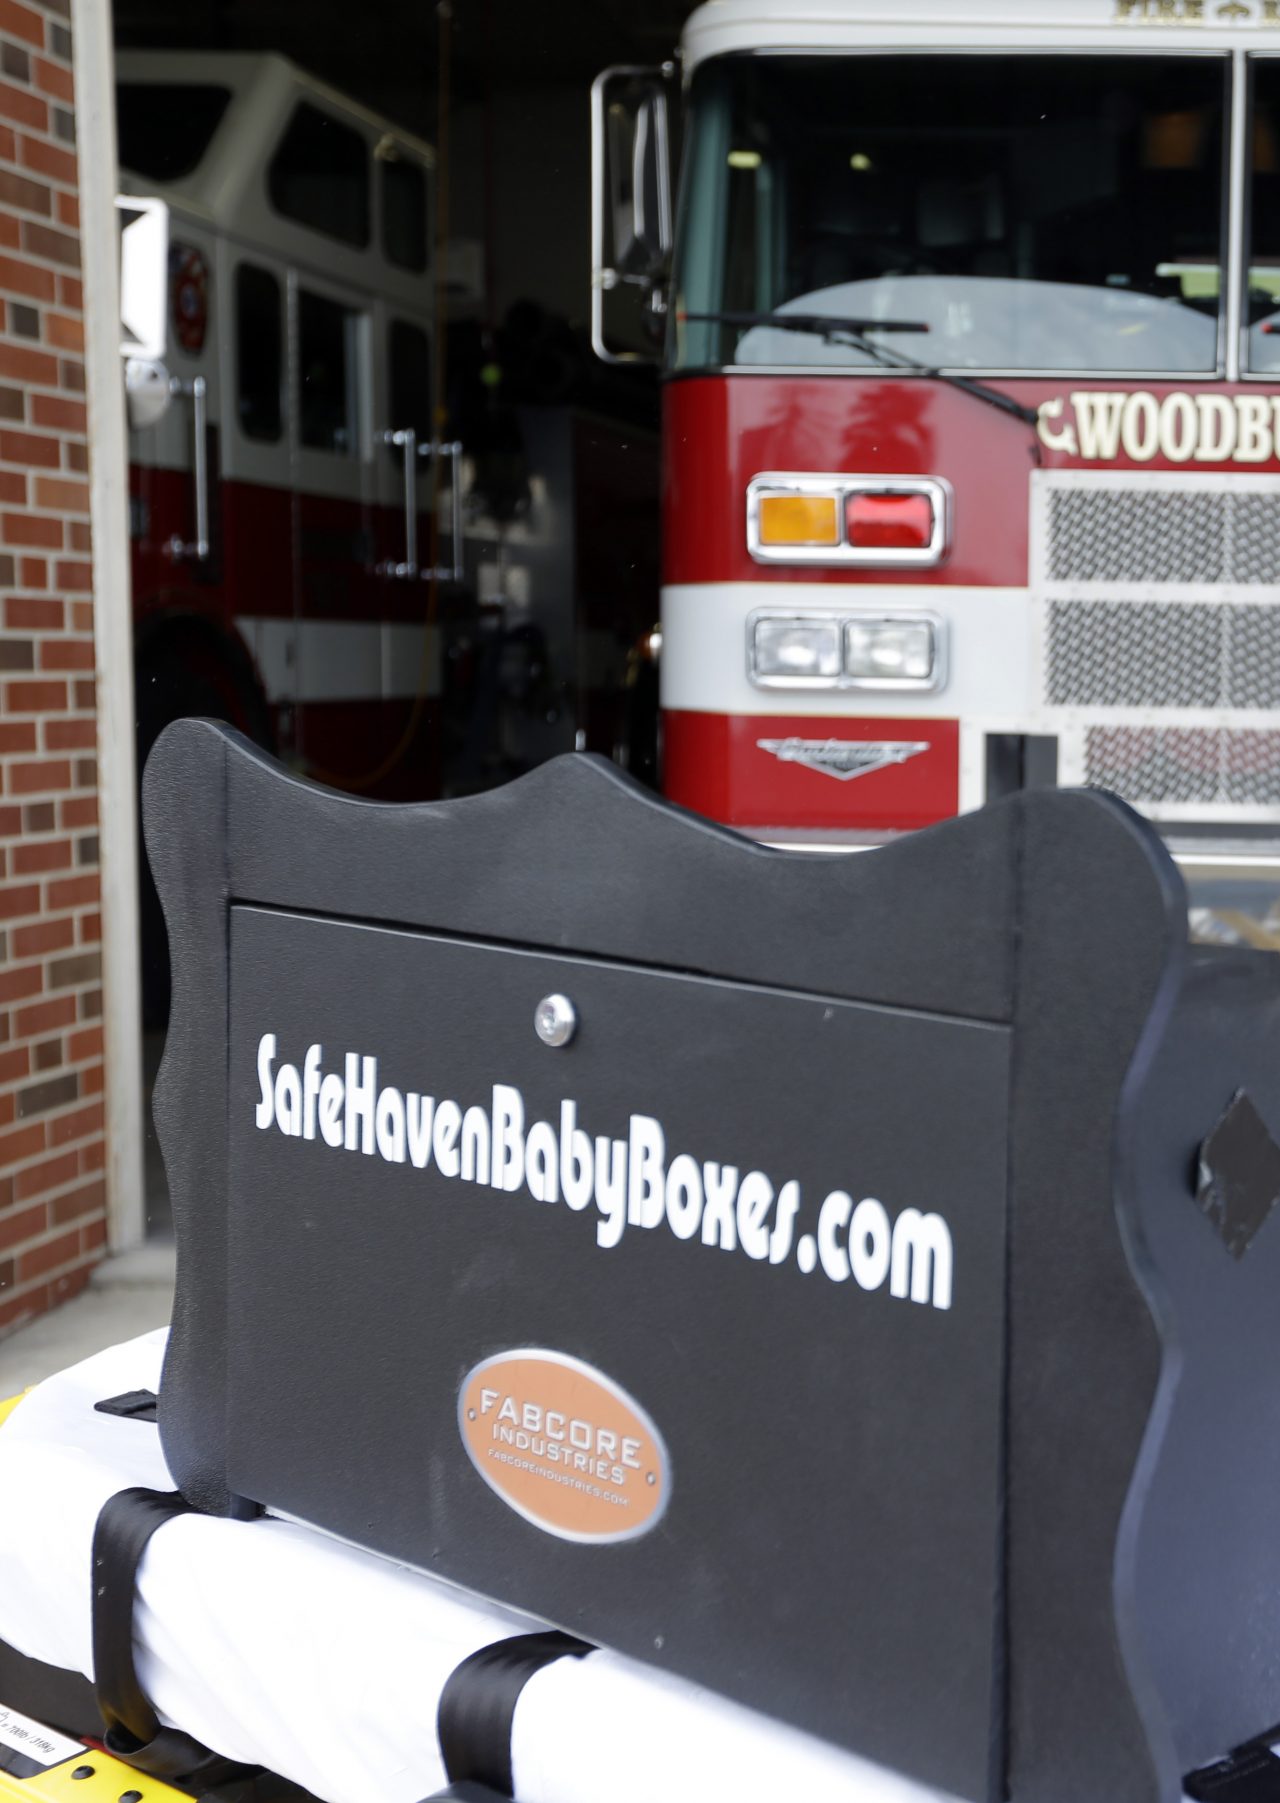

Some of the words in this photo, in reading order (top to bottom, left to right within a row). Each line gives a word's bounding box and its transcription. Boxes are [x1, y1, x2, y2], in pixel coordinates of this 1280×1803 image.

[1110, 0, 1203, 26] FIRE
[255, 1032, 953, 1311] SafeHavenBabyBoxes.com
[479, 1387, 644, 1470] FABCORE
[491, 1422, 626, 1486] INDUSTRIES
[487, 1447, 631, 1507] FABCOREINDUSTRIES.COM
